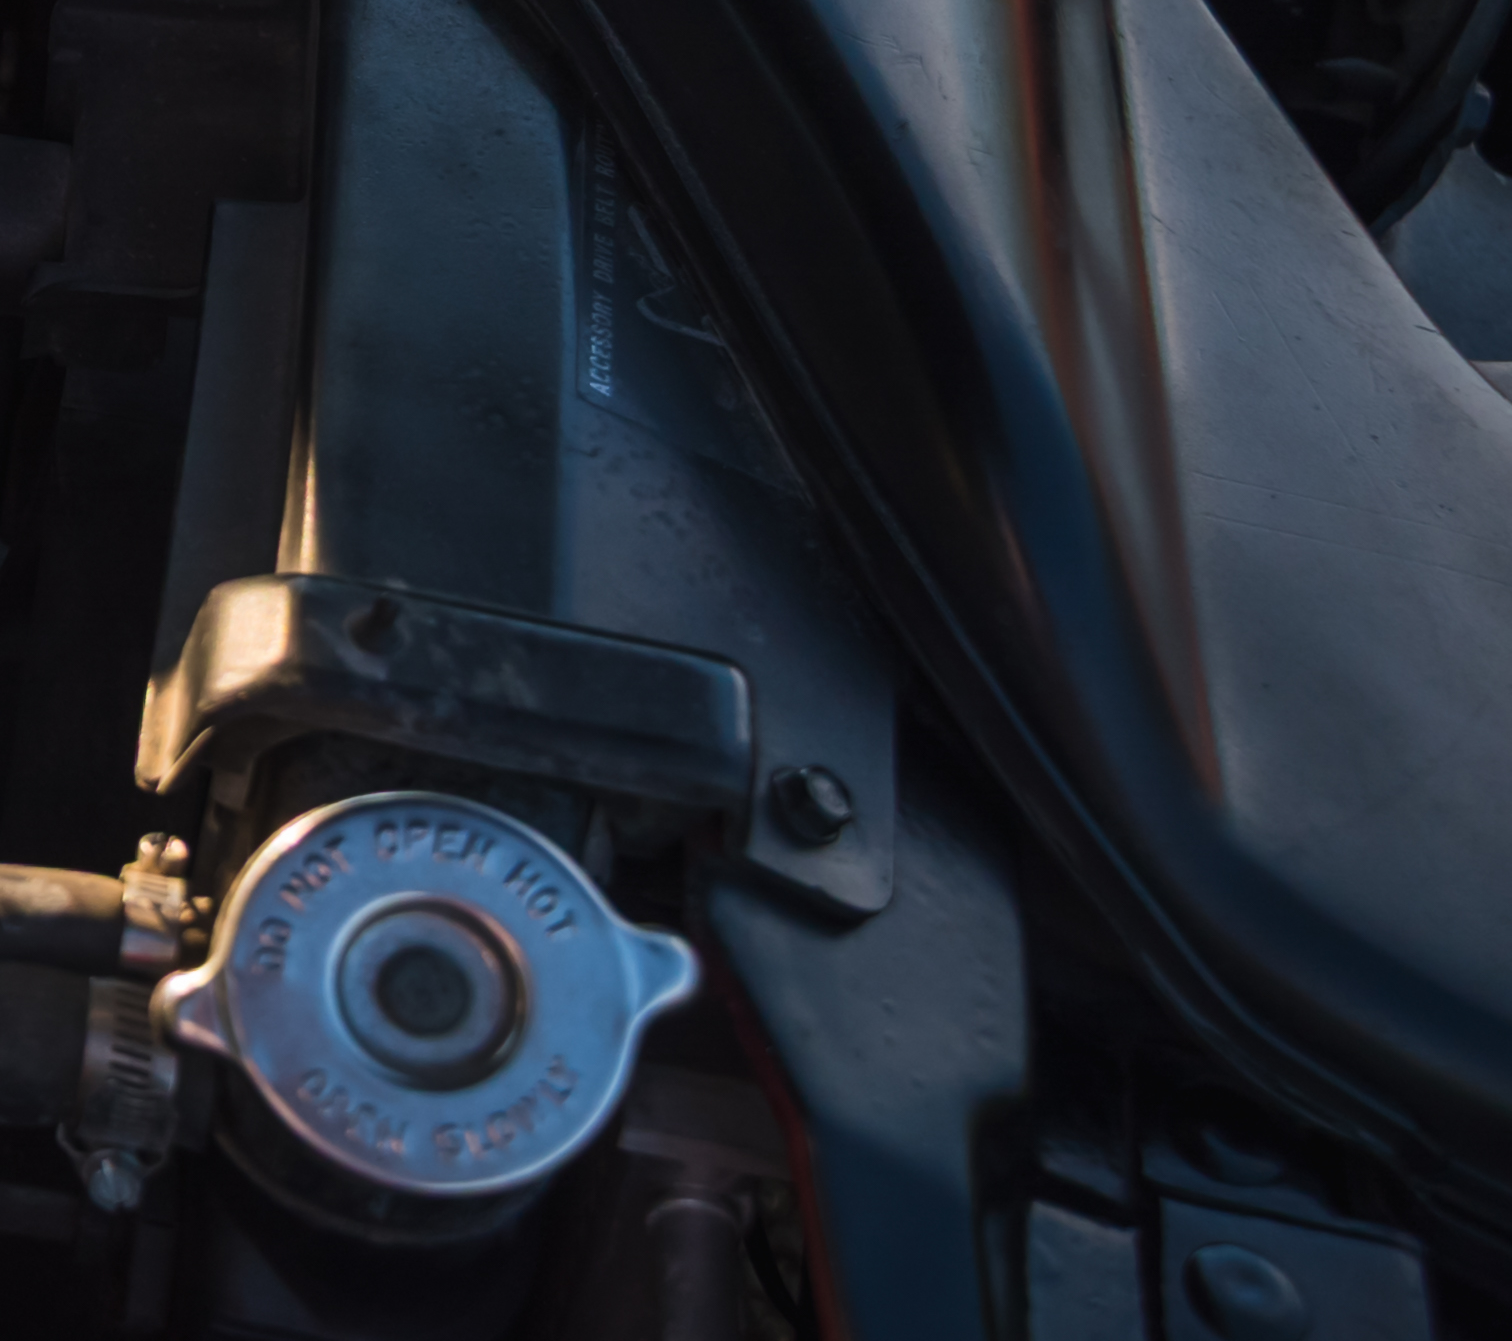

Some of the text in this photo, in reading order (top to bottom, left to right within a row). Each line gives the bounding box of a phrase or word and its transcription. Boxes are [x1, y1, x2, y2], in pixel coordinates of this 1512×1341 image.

[589, 119, 616, 397] ACCESSORY DRIVE BELT ROUT
[253, 817, 580, 978] DO NOT OPEN HOT
